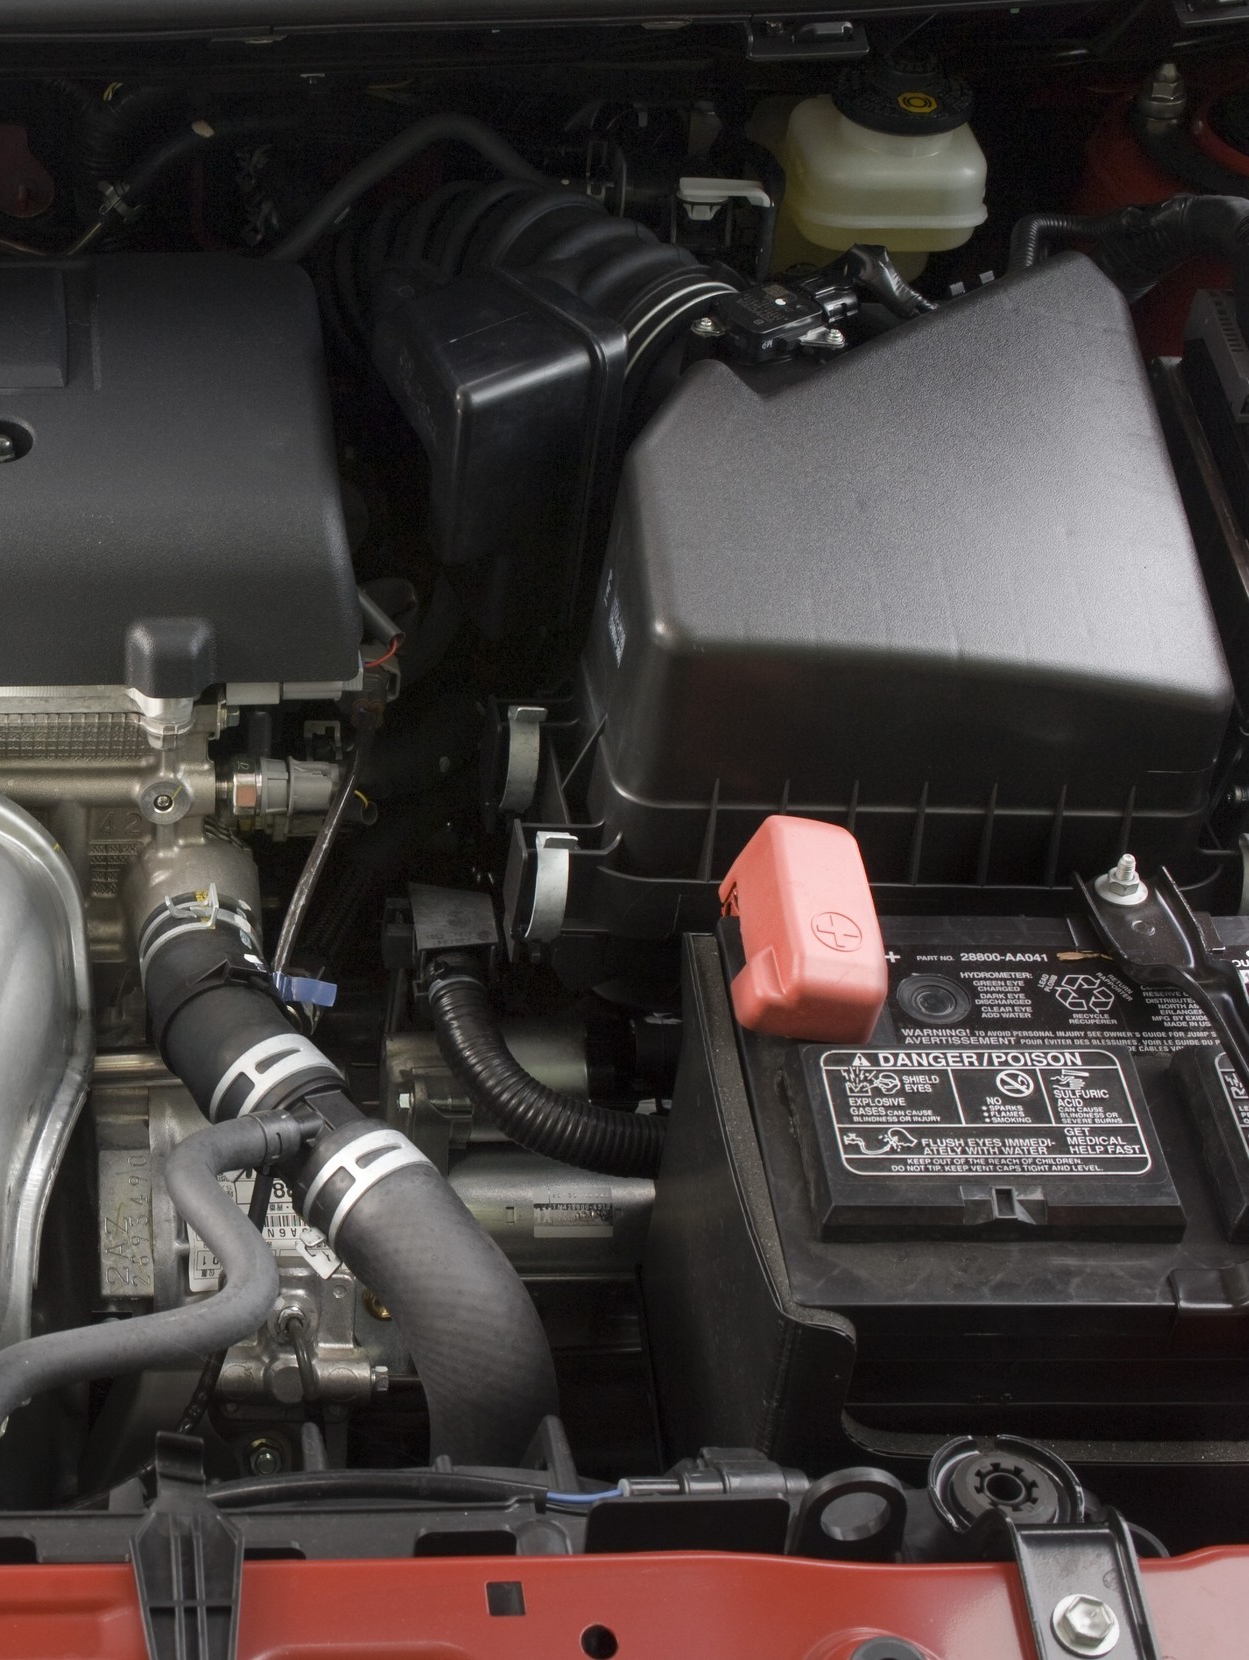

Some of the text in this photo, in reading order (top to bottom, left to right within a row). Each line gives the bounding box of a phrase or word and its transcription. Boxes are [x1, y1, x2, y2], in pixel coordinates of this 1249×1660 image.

[959, 953, 1048, 962] 28800-AA041
[959, 971, 1033, 980] HYDROMETER:
[1037, 973, 1049, 988] LEAD
[1107, 973, 1133, 995] RETURN
[1095, 971, 1133, 1002] RAPPORTER
[901, 1028, 971, 1037] WARNING!
[904, 1037, 1017, 1045] AVERTISSEMENT
[902, 1075, 939, 1084] SHIELD
[905, 1084, 932, 1093] EYES
[1053, 1089, 1109, 1098] SULFURIC
[848, 1098, 907, 1106] EXPLOSIVE
[986, 1097, 1002, 1105] NO
[1057, 1099, 1084, 1107] ACID
[850, 1107, 886, 1116] GASES
[1064, 1127, 1090, 1136] GET
[921, 1138, 1056, 1147] FLUSH EYES IMMEDI-
[1066, 1136, 1127, 1145] MEDICAL
[923, 1146, 1048, 1155] ATELY WITH WATER
[1069, 1145, 1141, 1154] HELP FAST
[104, 1216, 129, 1285] 2AZ
